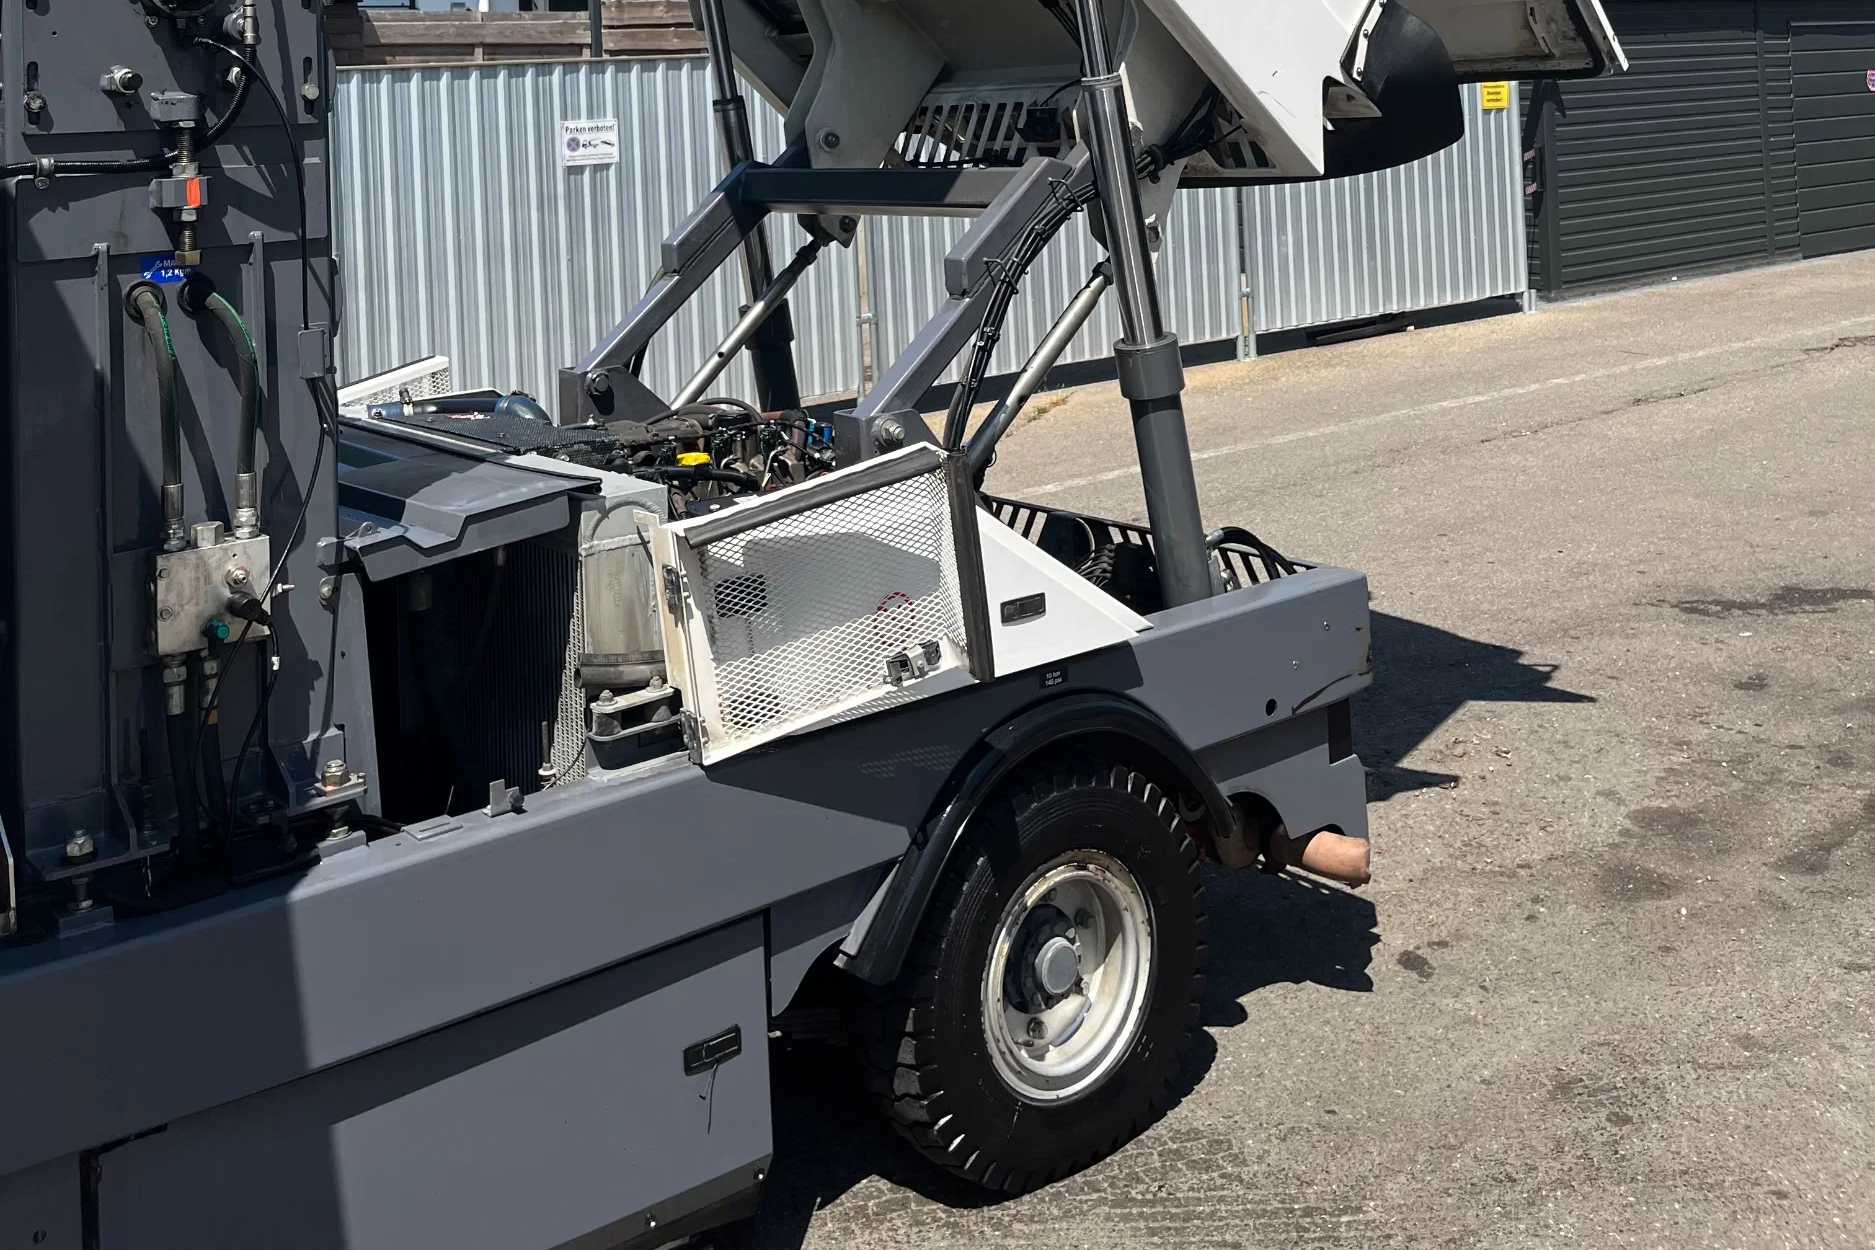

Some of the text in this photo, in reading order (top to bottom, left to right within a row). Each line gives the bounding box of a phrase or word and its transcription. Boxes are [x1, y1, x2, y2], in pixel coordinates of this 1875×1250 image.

[566, 124, 615, 134] Parken verboten!
[161, 269, 173, 278] 1,2
